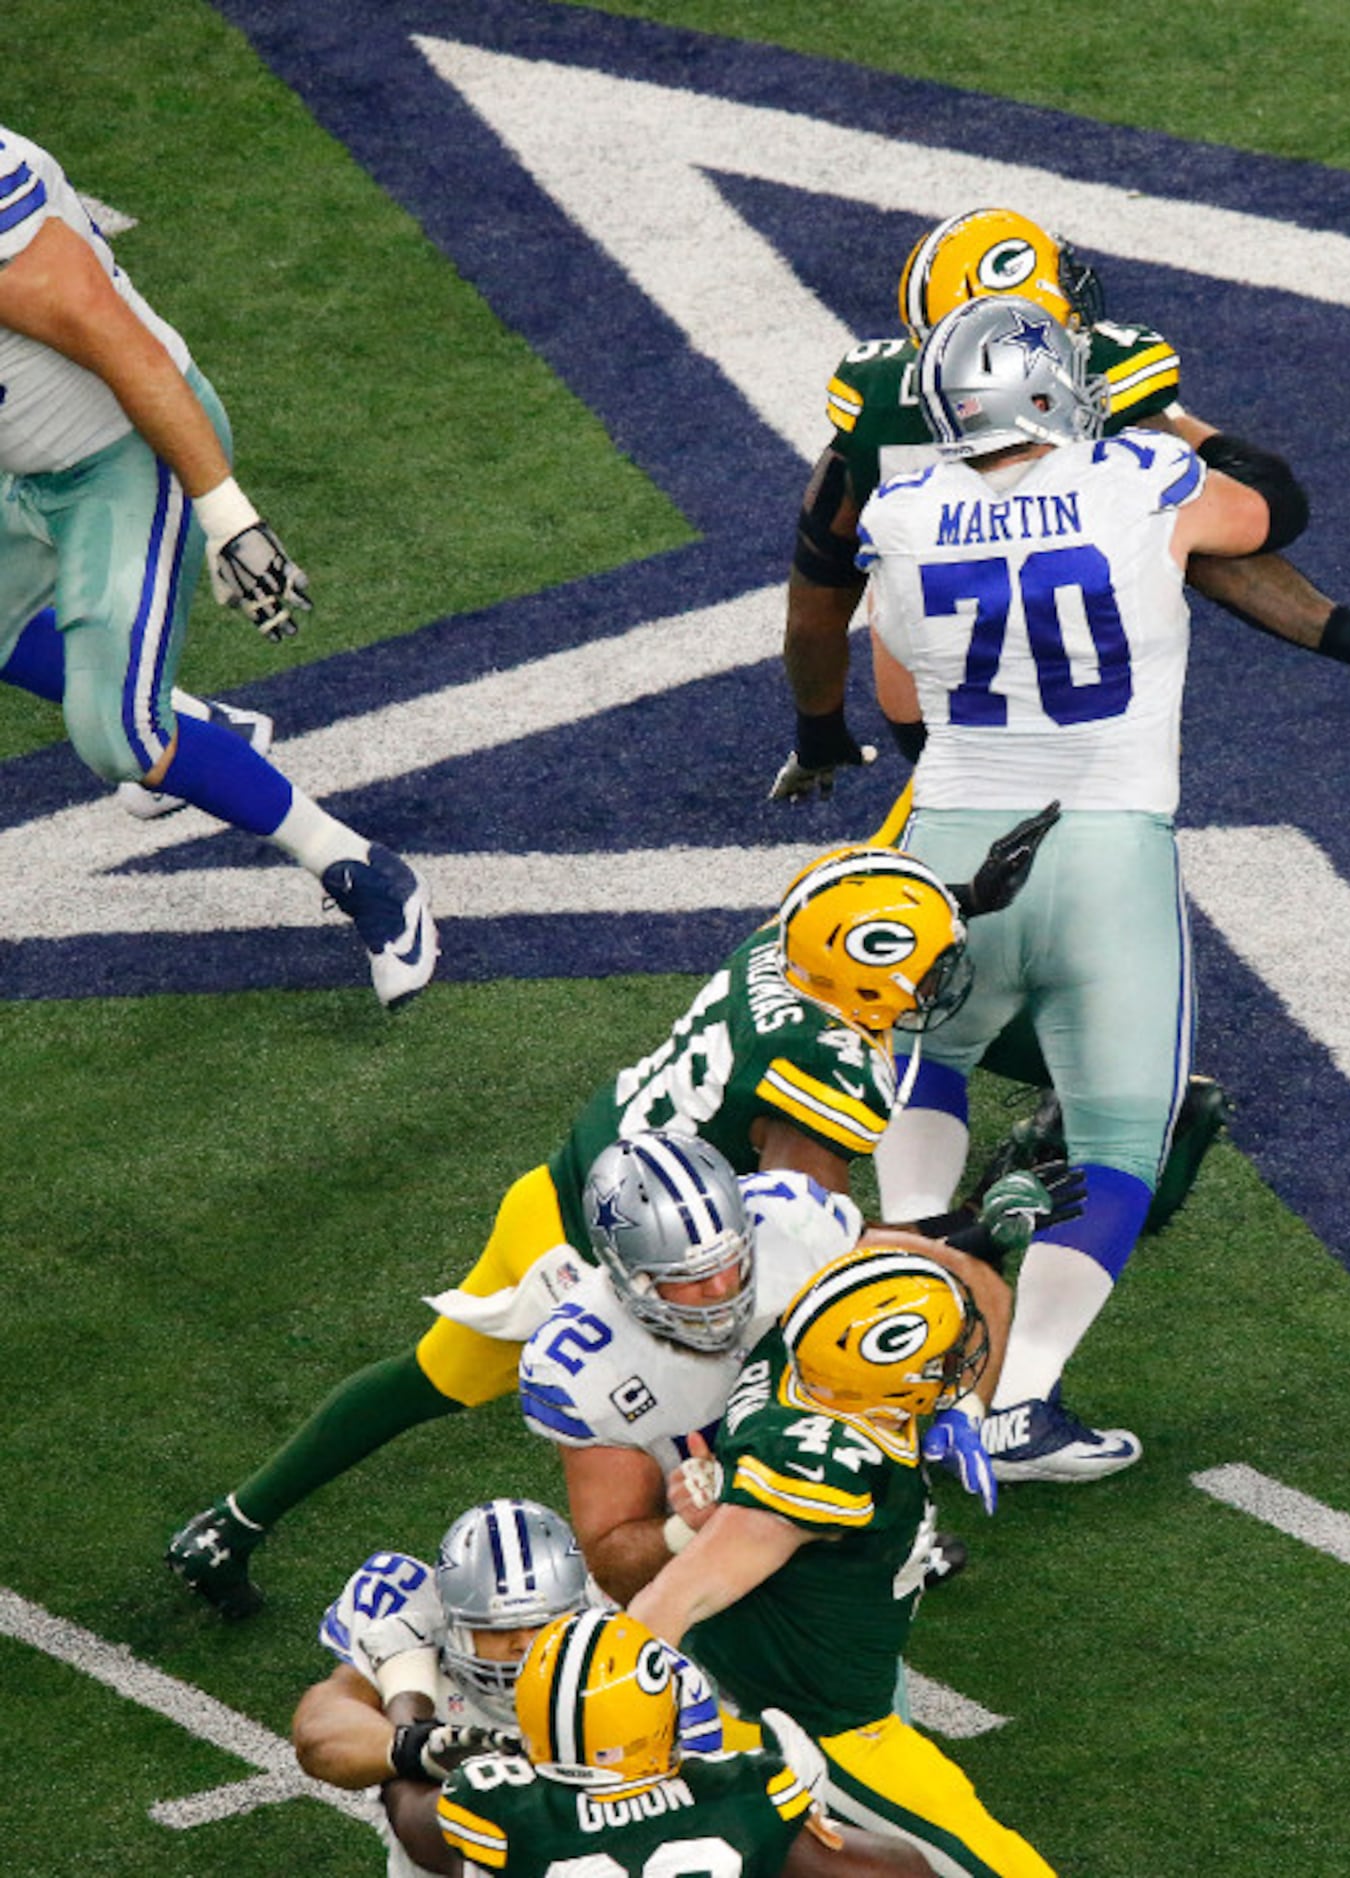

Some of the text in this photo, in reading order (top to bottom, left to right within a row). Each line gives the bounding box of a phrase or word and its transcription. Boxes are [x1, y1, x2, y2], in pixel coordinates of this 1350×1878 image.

[936, 492, 1082, 546] MARTIN
[920, 544, 1133, 726] 70
[783, 1415, 884, 1474] 47
[577, 1777, 695, 1833] GUION
